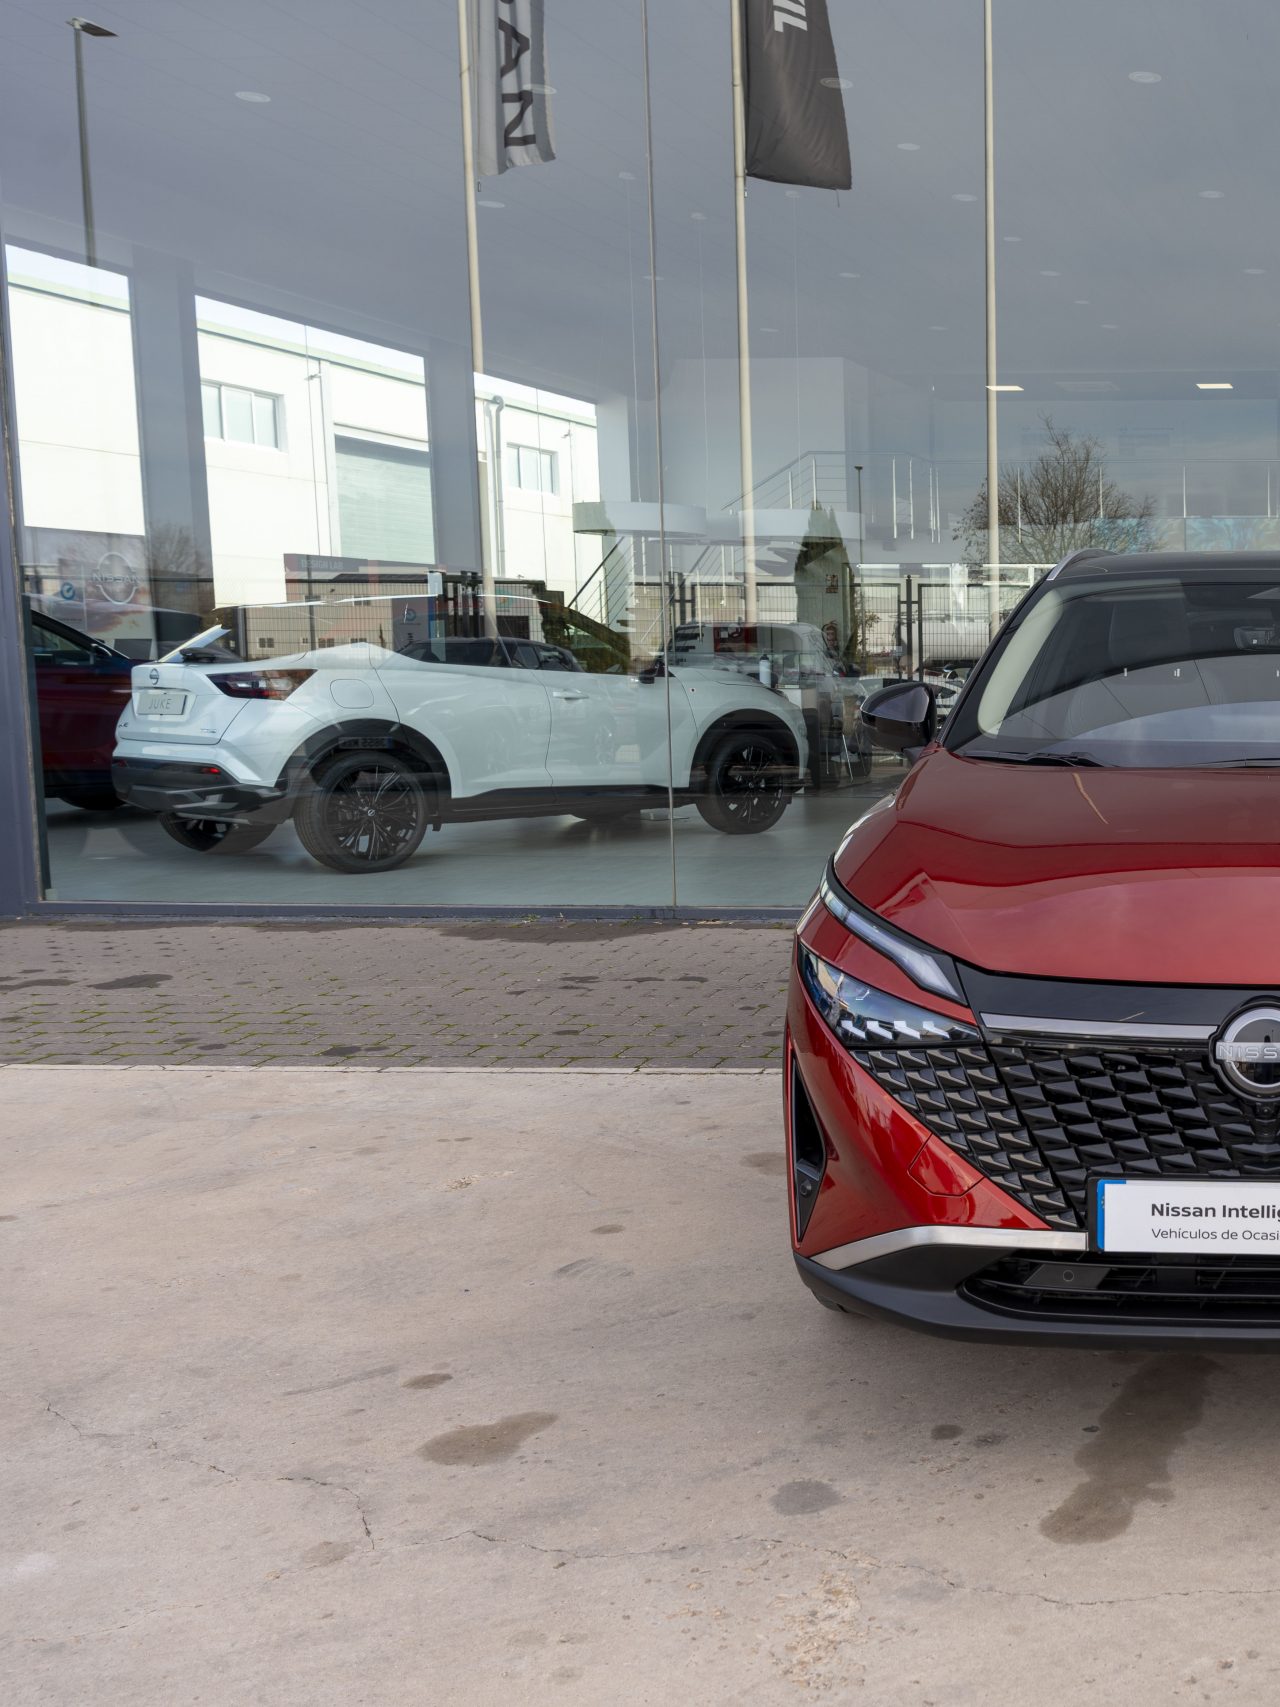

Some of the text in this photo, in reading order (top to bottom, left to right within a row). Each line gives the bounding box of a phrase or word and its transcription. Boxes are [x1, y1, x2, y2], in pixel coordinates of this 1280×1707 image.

[497, 0, 537, 148] AN
[148, 698, 172, 710] JUKE
[1151, 1202, 1217, 1218] Nissan
[1151, 1227, 1218, 1240] Vehículos
[1221, 1229, 1239, 1241] de
